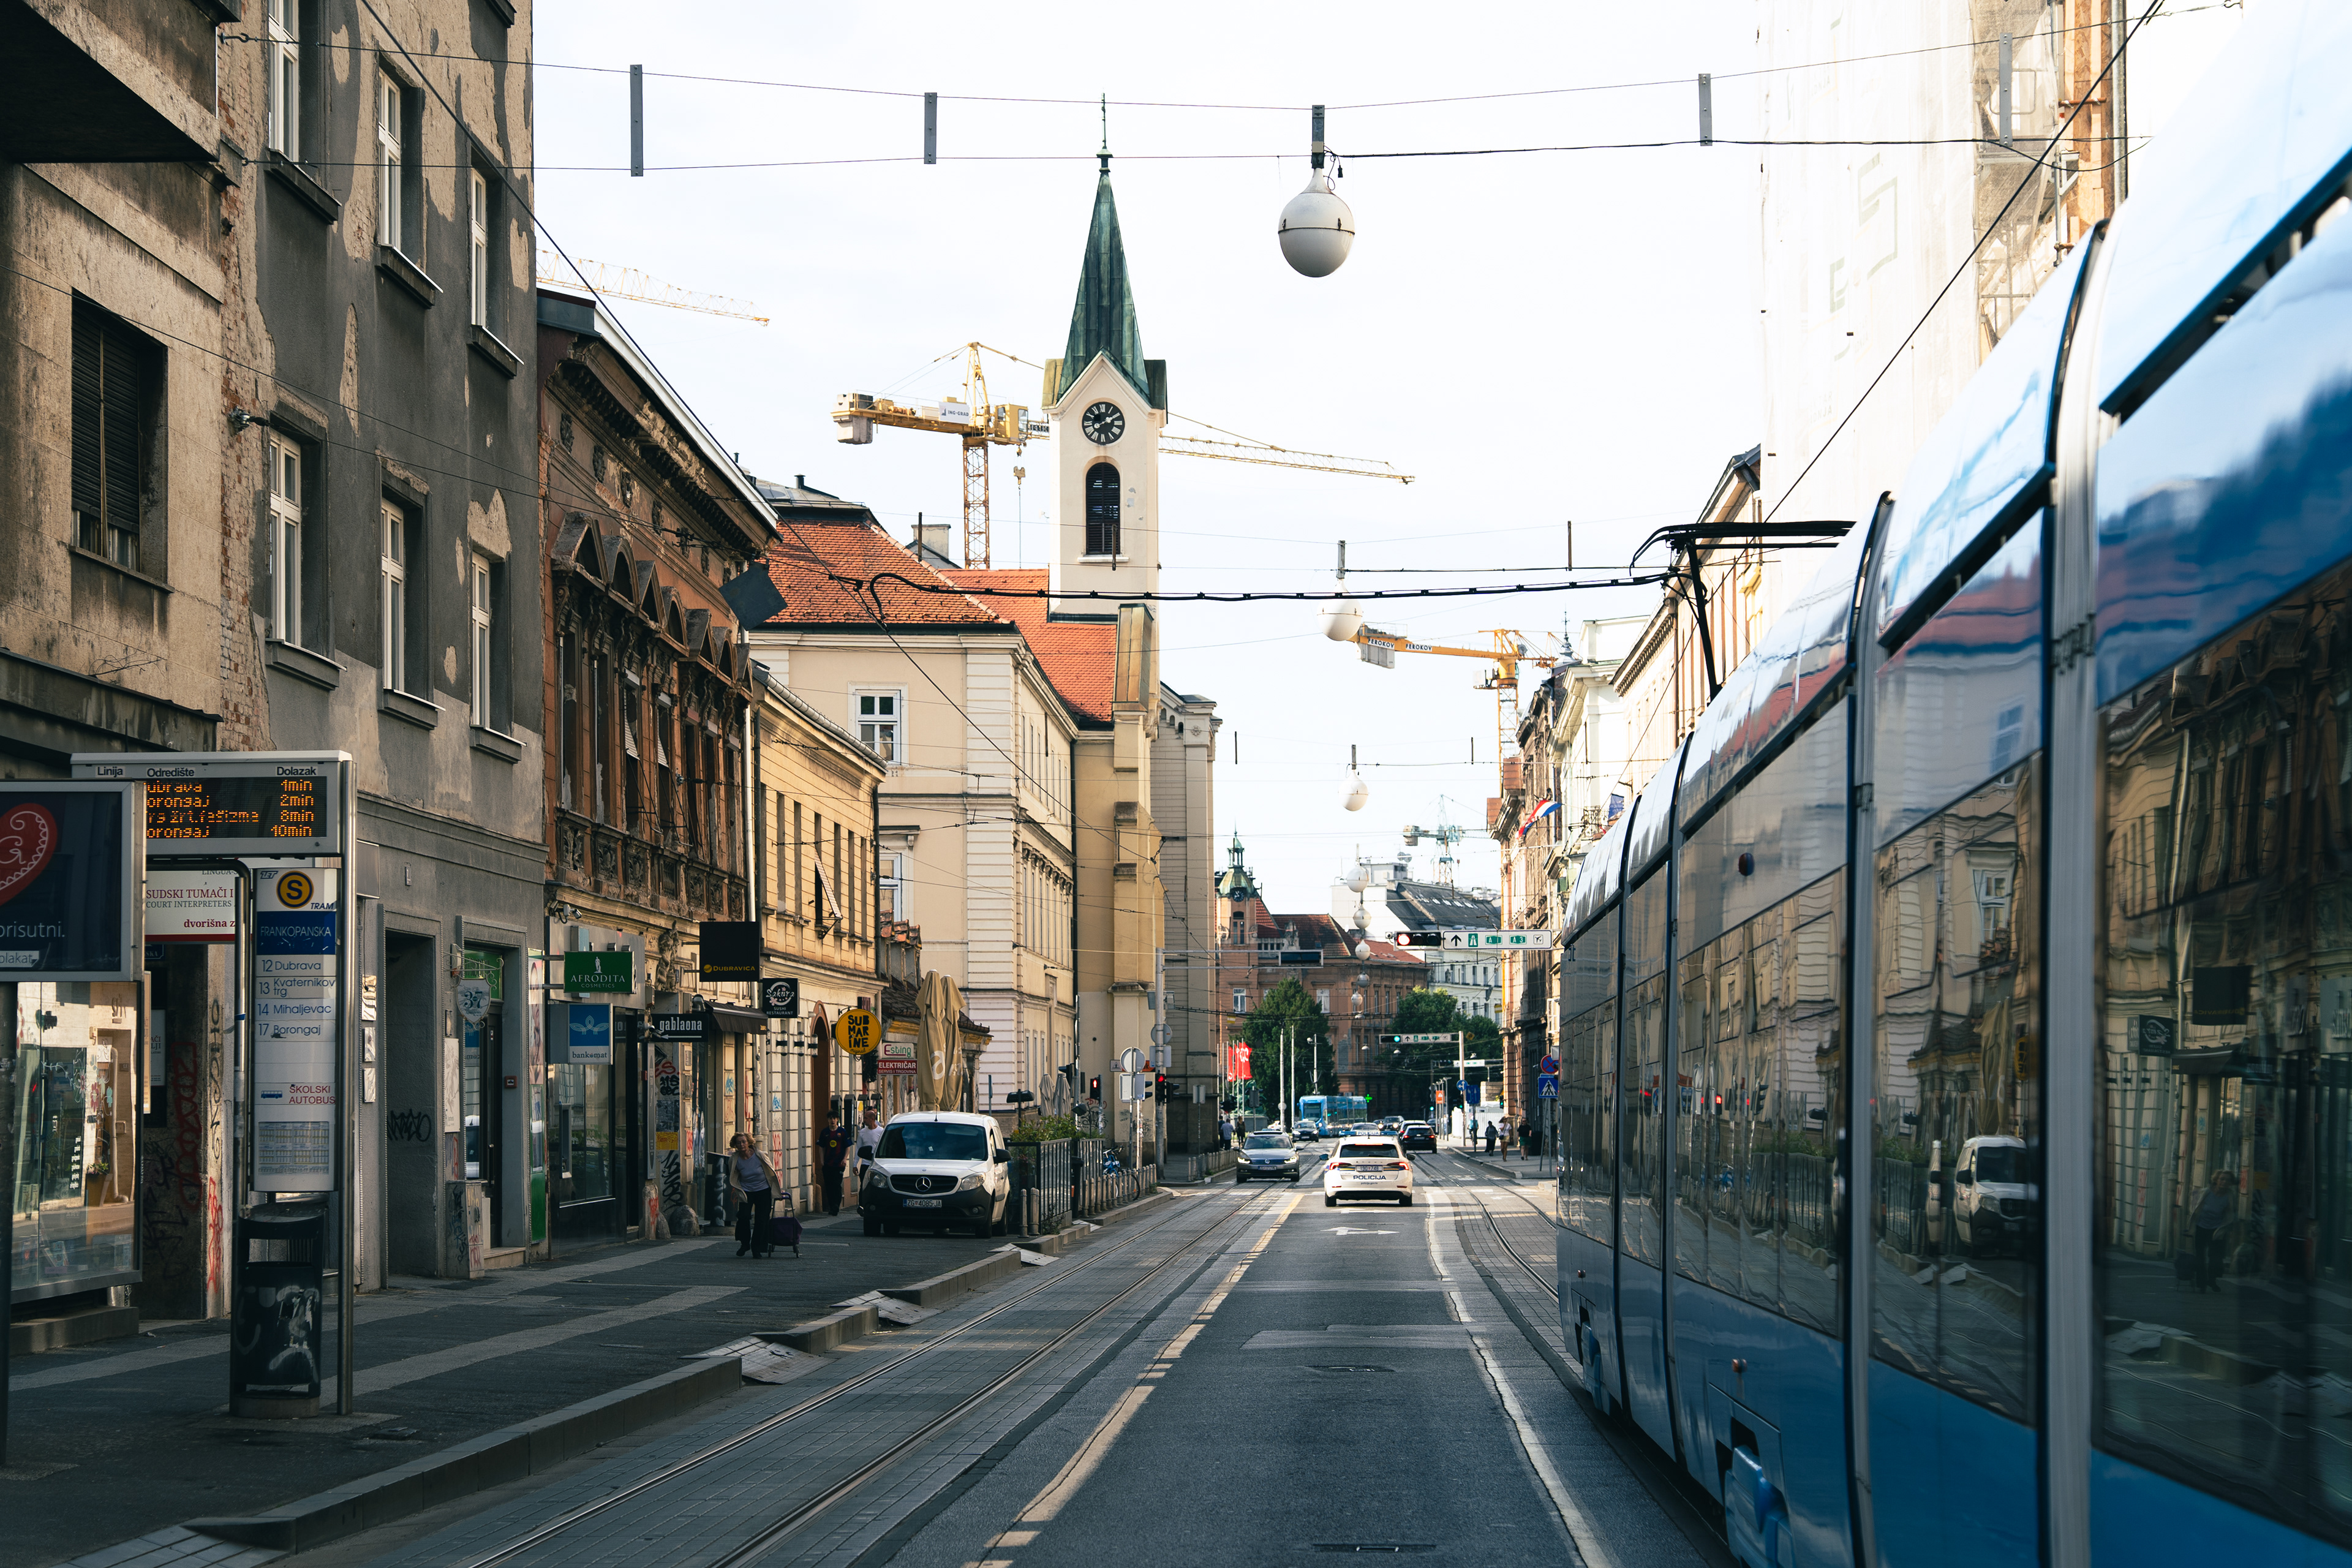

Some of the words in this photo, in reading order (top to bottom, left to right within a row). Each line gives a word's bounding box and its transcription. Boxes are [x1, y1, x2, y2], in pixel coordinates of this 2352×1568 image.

[97, 766, 123, 777] Linija
[146, 767, 195, 777] Odredište
[276, 766, 316, 776] Dolazak
[145, 781, 203, 793] ubrava
[281, 779, 312, 791] 1min
[146, 796, 210, 808] orongaj
[280, 794, 314, 807] 2min
[280, 810, 314, 822] 8min
[146, 826, 210, 839] orongaj
[271, 824, 312, 837] 10min
[260, 870, 279, 879] ZET
[146, 889, 183, 899] SUDSKI
[186, 886, 227, 899] TUMAČI
[286, 880, 303, 900] S
[184, 919, 227, 928] dvorišna
[260, 926, 331, 937] FRANKOPANSKA
[262, 959, 273, 971] 12
[275, 961, 321, 970] Dubrava
[259, 982, 270, 994] 13
[274, 978, 335, 987] Kvaternikov
[273, 987, 287, 998] trg
[766, 989, 795, 998] Sakura
[258, 1004, 269, 1016] 14
[274, 1005, 331, 1015] Mihaljevac
[659, 1017, 702, 1033] gablaona
[848, 1015, 869, 1026] SUB
[258, 1023, 269, 1036] 17
[274, 1025, 321, 1036] Borongaj
[848, 1025, 869, 1037] MAR
[884, 1044, 911, 1058] Esting
